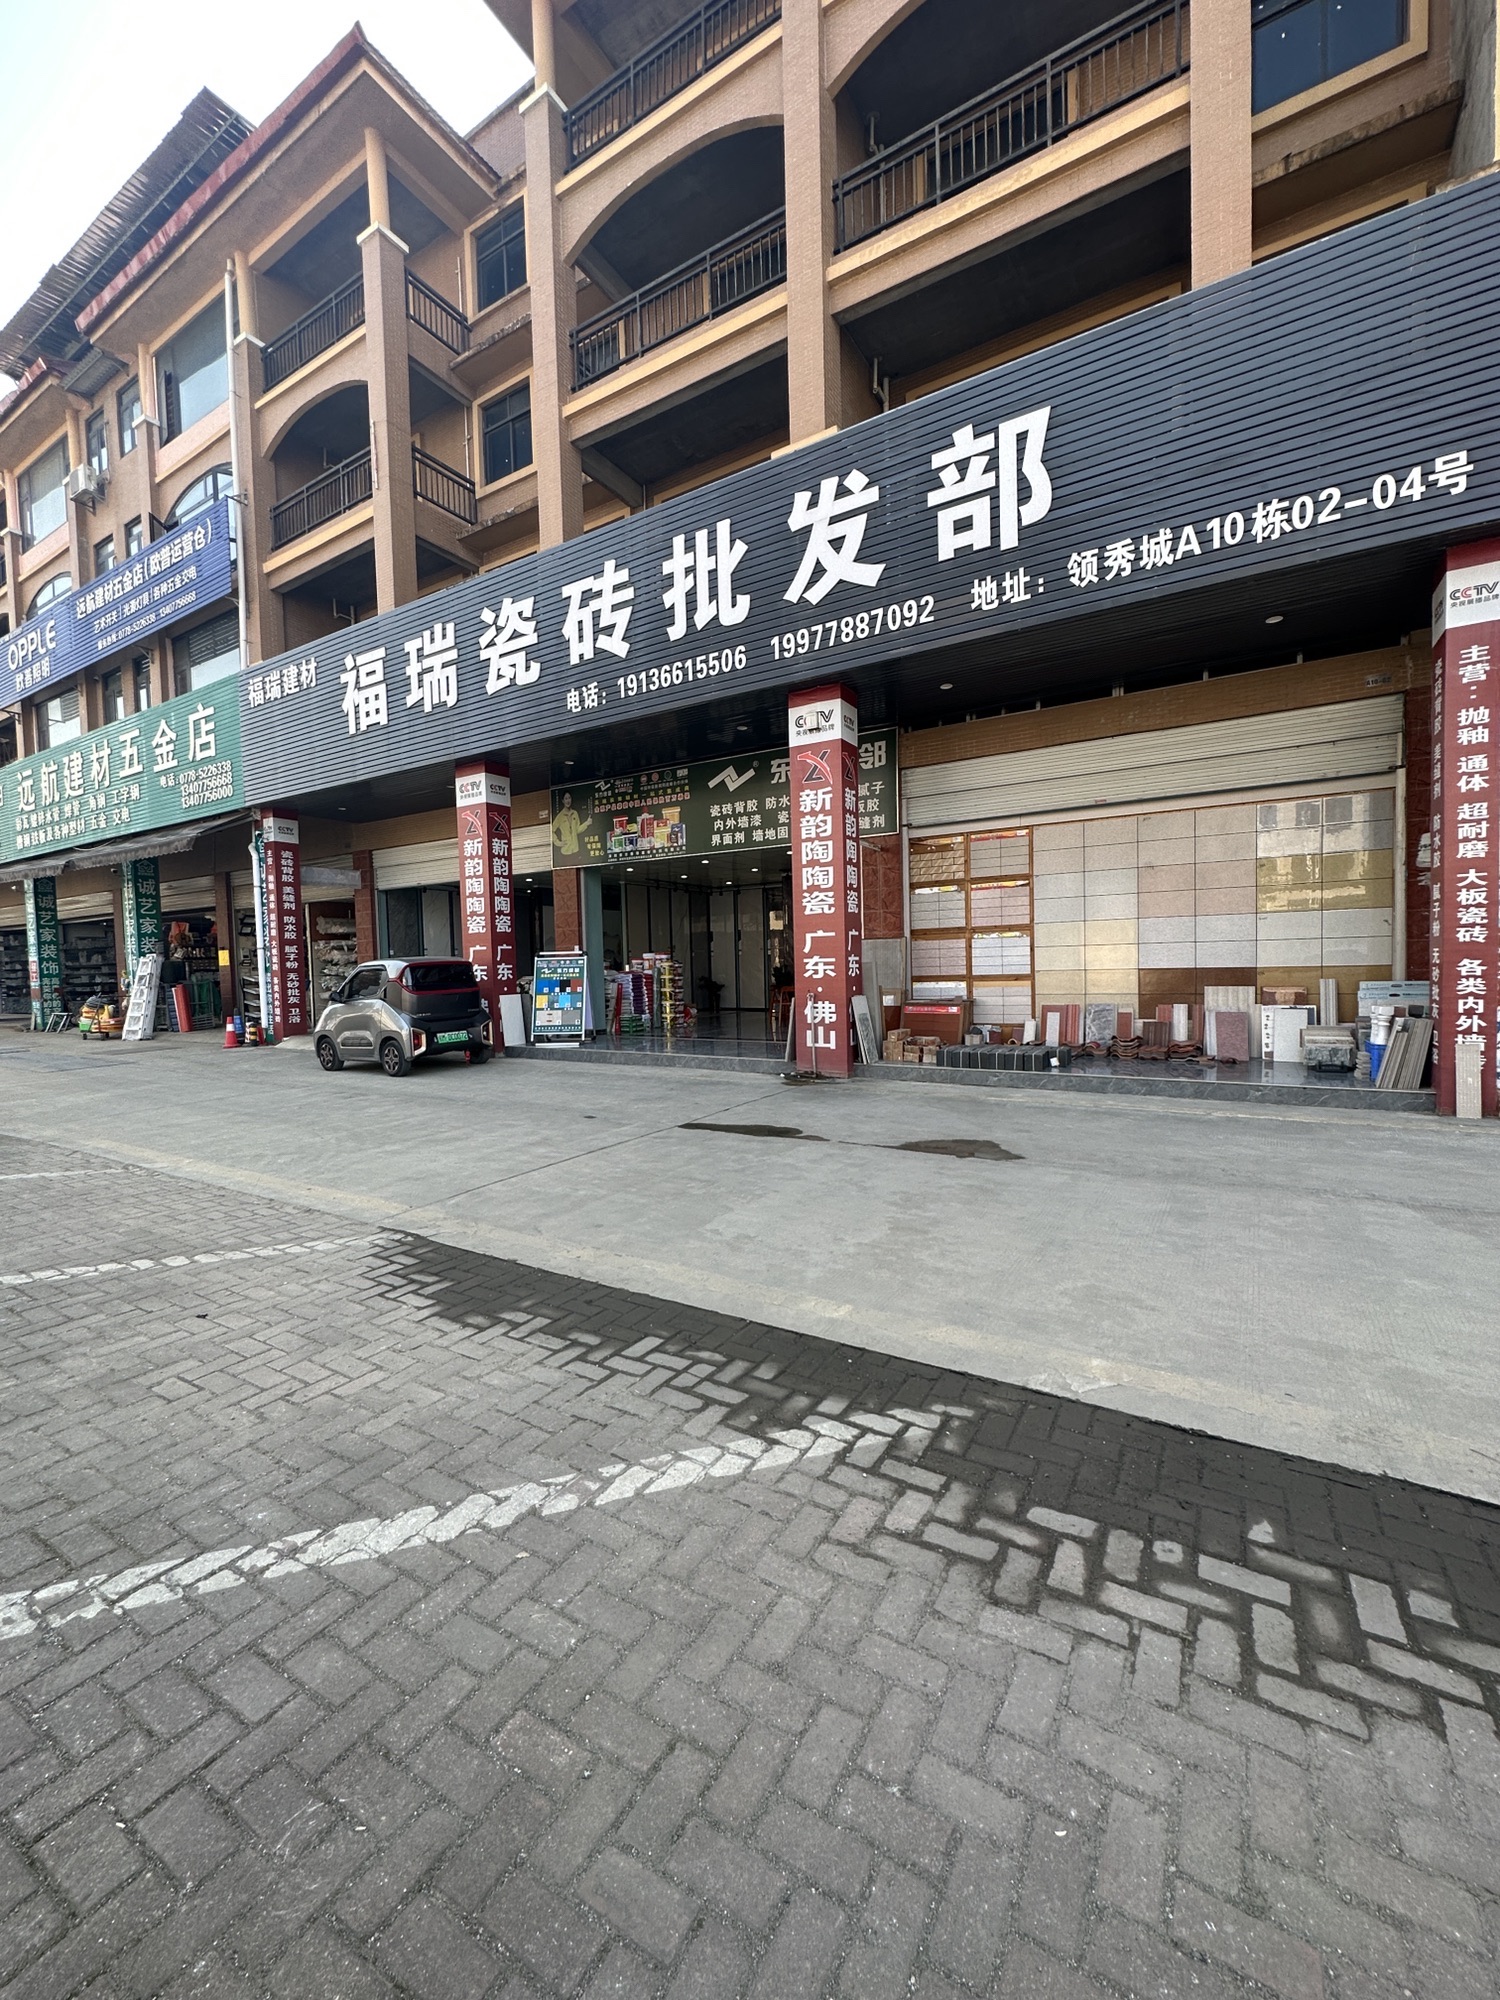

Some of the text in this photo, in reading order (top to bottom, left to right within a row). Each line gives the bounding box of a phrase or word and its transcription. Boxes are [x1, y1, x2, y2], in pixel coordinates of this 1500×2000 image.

[339, 404, 1053, 735] 福瑞瓷砖批发部
[565, 450, 1475, 713] 电话： 19136615506 19977887092 地址： 领秀城A10栋02-04号
[1449, 581, 1500, 601] CCTV
[8, 619, 57, 671] OPPLE
[15, 656, 51, 692] 欧普照明
[247, 657, 318, 708] 福瑞建材
[1456, 706, 1491, 746] 抛釉
[17, 702, 217, 811] 远航建材五金店
[1456, 753, 1490, 793] 通体
[181, 771, 233, 797] 13407756668
[181, 785, 234, 809] 13407756000
[459, 780, 482, 794] CCTV
[90, 812, 107, 831] 五金
[710, 799, 758, 817] 瓷砖背胶
[714, 814, 762, 832] 内外墙漆
[711, 831, 745, 847] 界面剂
[752, 826, 789, 842] 墙地固
[1456, 801, 1490, 859] 超耐磨
[281, 850, 295, 883] 瓷砖背胶
[799, 786, 836, 915] 新韵陶陶瓷
[844, 787, 859, 914] 新韵陶陶瓷
[463, 838, 487, 934] 新韵陶陶瓷
[492, 838, 512, 933] 新韵陶陶瓷
[1455, 868, 1489, 943] 大板瓷砖
[37, 894, 59, 975] 诚艺家装饰
[283, 916, 297, 940] 防水胶
[286, 972, 301, 1004] 无砂批灰
[288, 1008, 302, 1024] 卫浴
